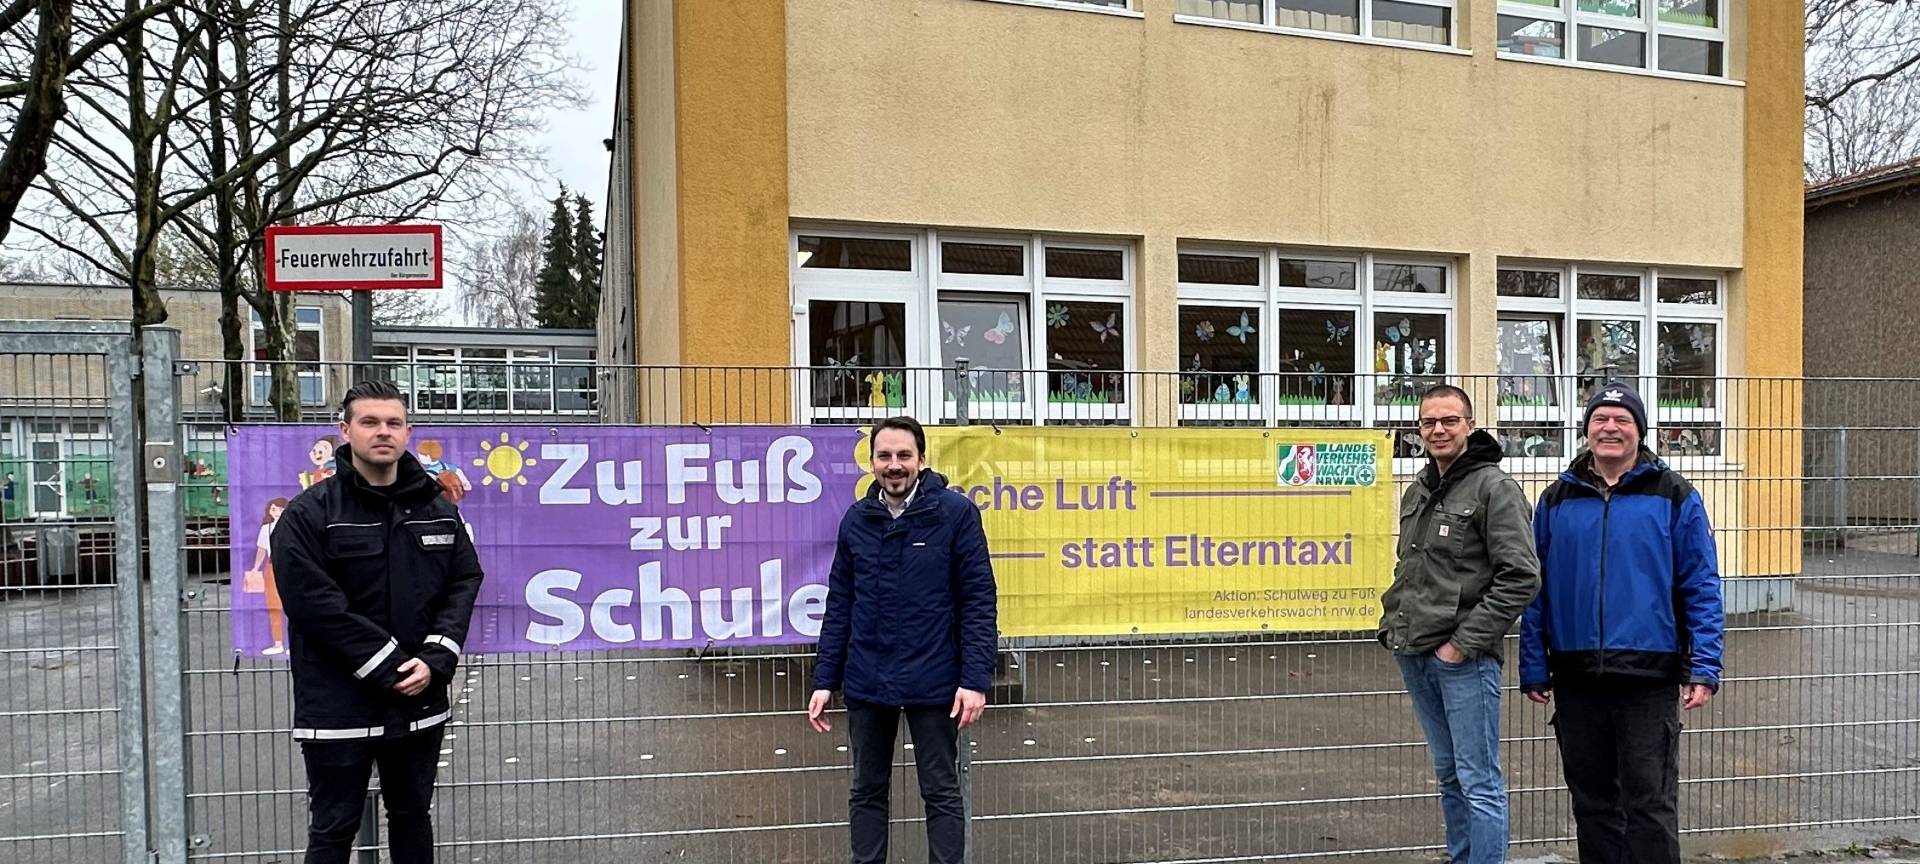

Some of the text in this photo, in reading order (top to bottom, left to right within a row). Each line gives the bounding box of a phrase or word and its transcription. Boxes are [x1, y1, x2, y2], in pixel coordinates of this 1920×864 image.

[281, 247, 429, 269] Feuerwehrzufahrt
[1328, 443, 1377, 452] LANDES
[1316, 453, 1377, 465] VERKEHRS
[539, 435, 823, 506] Zu Fuß
[1316, 465, 1358, 476] WACHT
[1316, 477, 1343, 486] NRW
[1055, 475, 1137, 511] Luft
[630, 515, 732, 551] zur
[1061, 533, 1352, 568] statt Elterntaxi
[525, 558, 830, 645] Schule
[1213, 587, 1377, 604] Aktion: Schulweg zu Fuß
